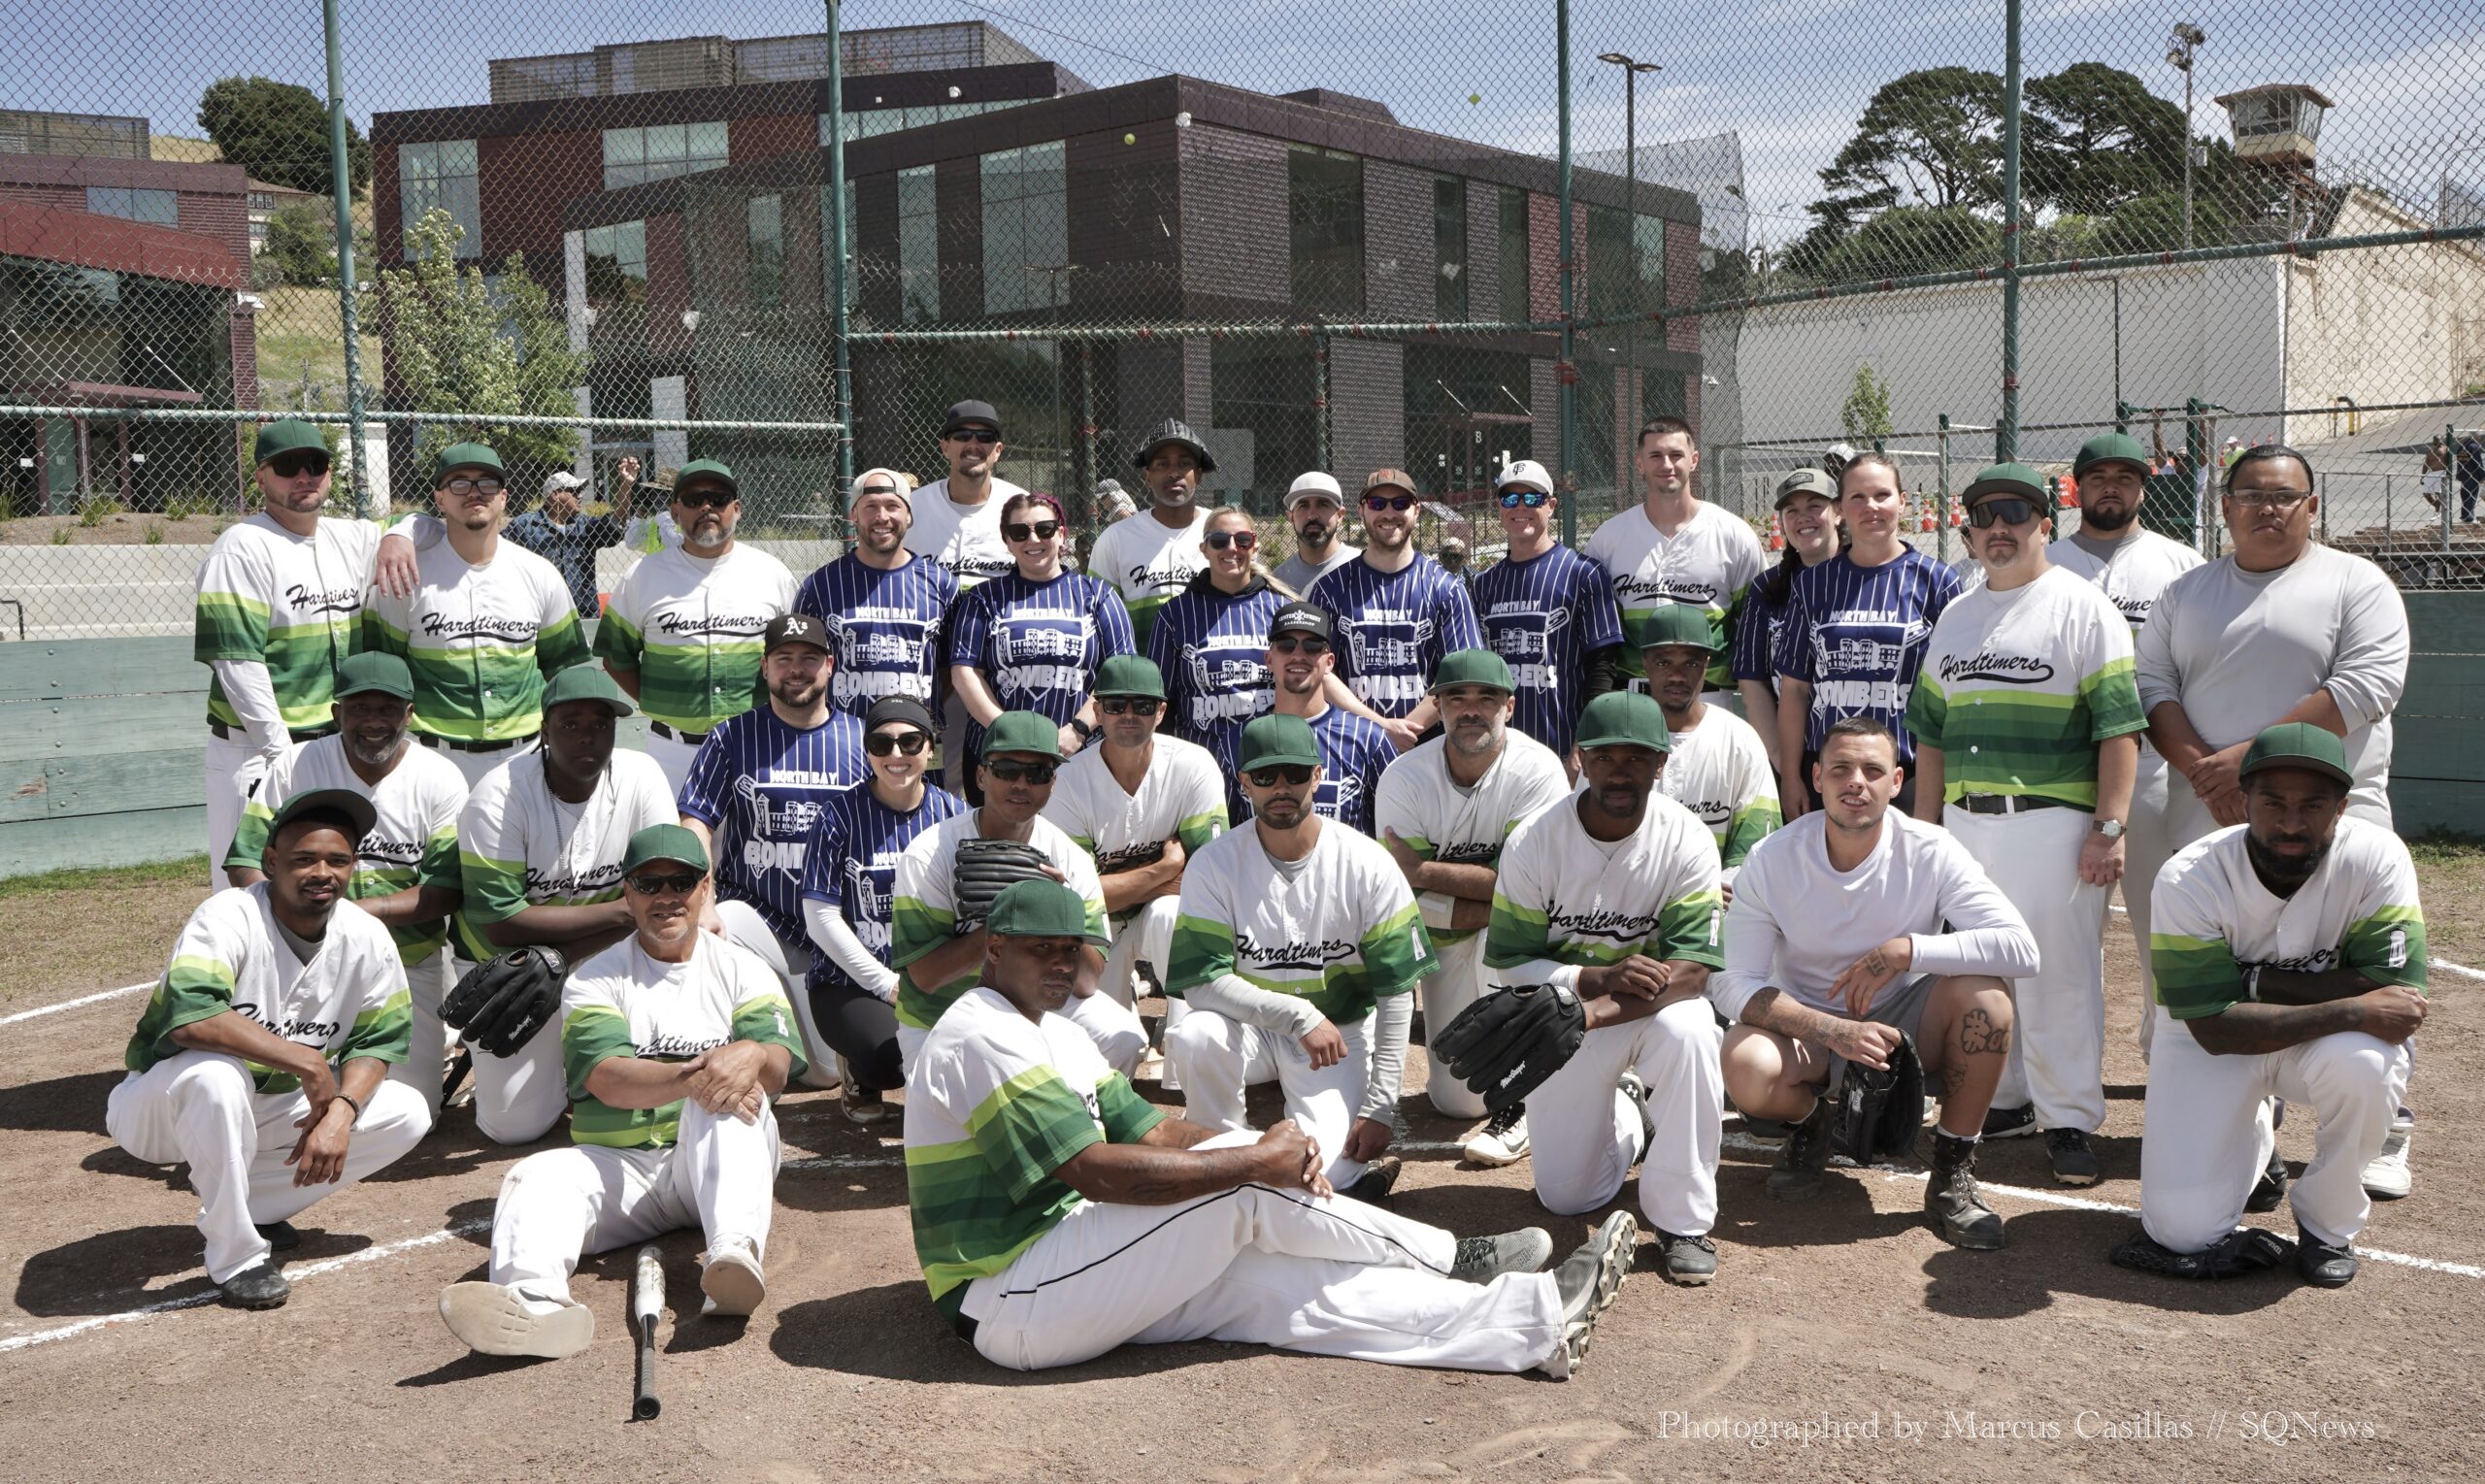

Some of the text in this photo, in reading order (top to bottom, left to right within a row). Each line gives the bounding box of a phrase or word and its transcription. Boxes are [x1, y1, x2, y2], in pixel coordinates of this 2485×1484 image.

[1613, 574, 1710, 596] Hardtimers
[855, 607, 915, 620] NORTH BAY
[1012, 609, 1074, 619] NORTH BAY
[1392, 610, 1412, 621] BAY
[1491, 600, 1540, 613] NORTH BAY
[1830, 610, 1896, 622] NORTH BAY
[421, 611, 533, 637] Hardtimers
[658, 611, 767, 634] Hardtimers
[782, 616, 808, 637] A's
[1208, 636, 1241, 647] NORTH
[1508, 664, 1557, 688] BERS
[1939, 653, 2039, 681] Hardtimers
[833, 671, 933, 699] BOMBERS
[1813, 680, 1911, 709] BOMBERS
[771, 771, 837, 784] NORTH BAY
